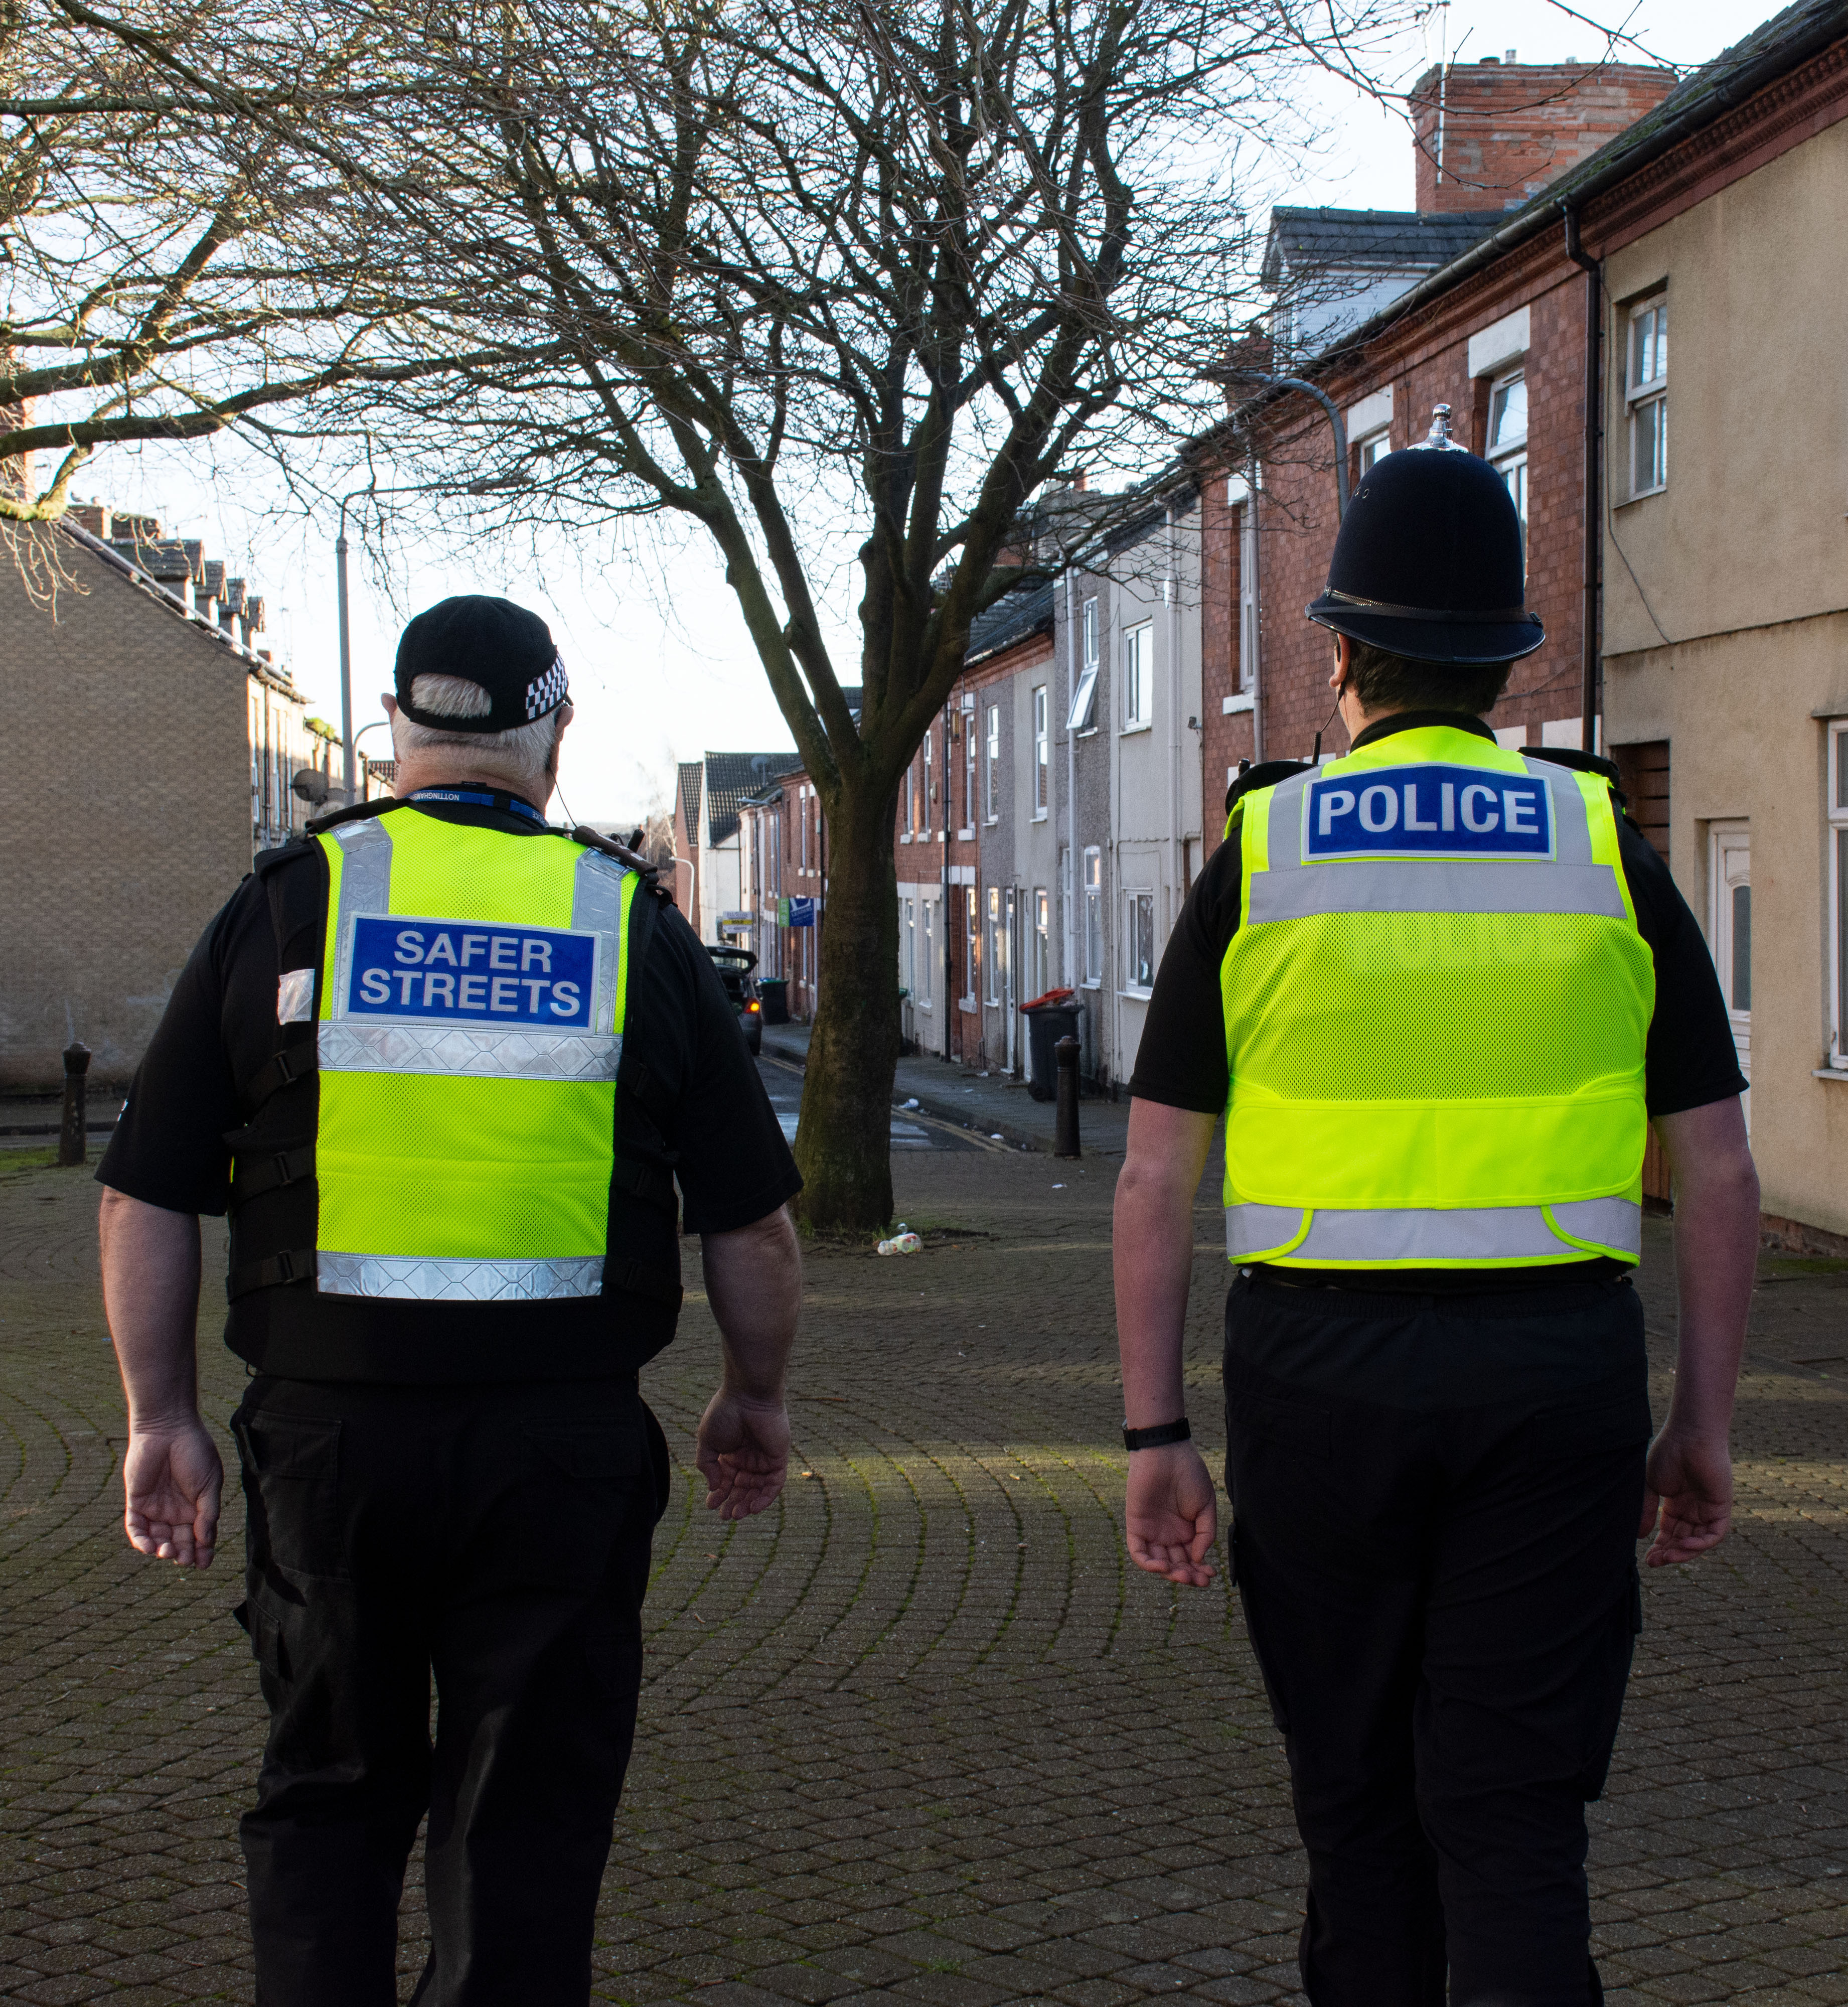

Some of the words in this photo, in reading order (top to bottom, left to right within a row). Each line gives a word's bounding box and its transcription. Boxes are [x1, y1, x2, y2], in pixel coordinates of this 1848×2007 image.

[1319, 783, 1539, 835] POLICE
[394, 931, 552, 973] SAFER
[360, 968, 580, 1017] STREETS
